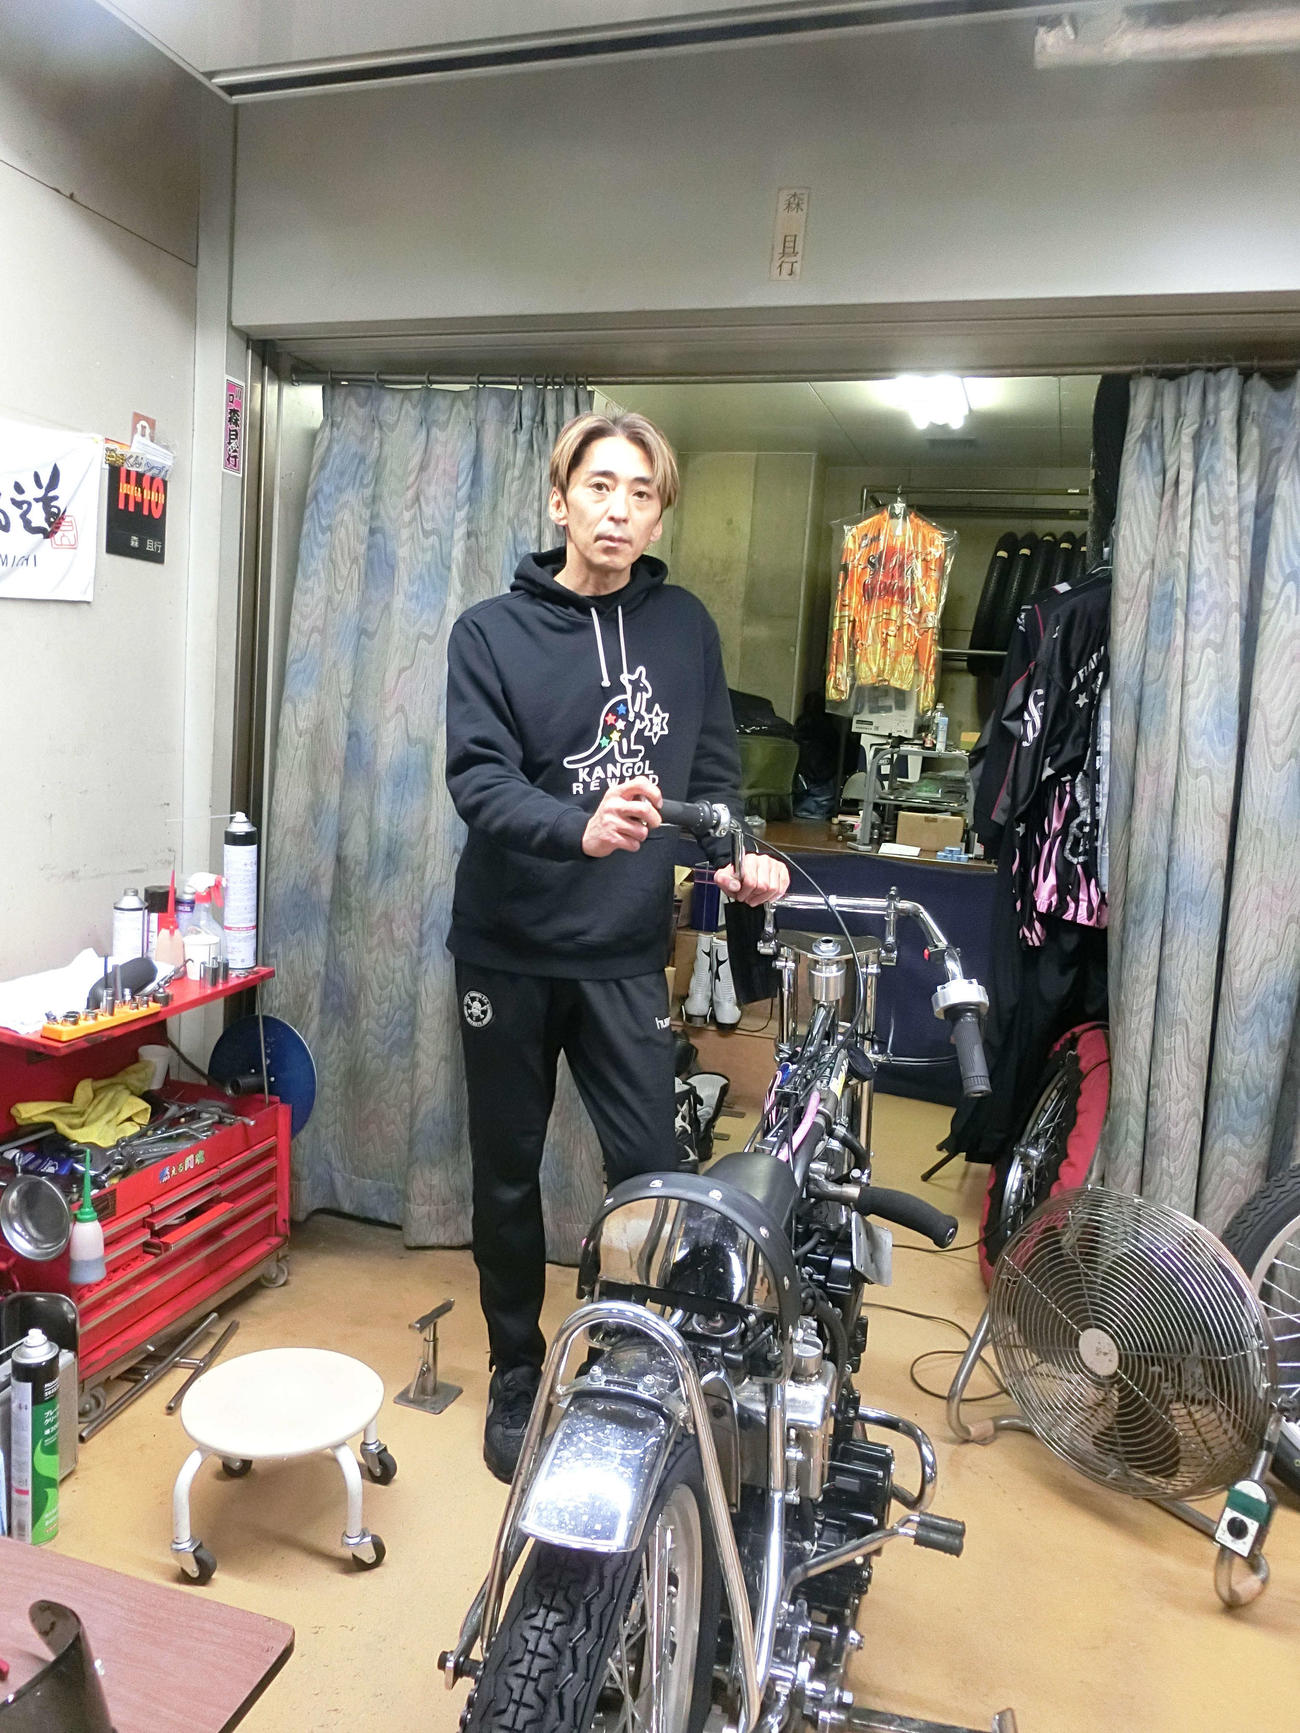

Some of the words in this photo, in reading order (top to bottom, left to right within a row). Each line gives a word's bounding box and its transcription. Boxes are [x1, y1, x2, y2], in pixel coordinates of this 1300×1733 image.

[783, 191, 805, 214] 森
[118, 467, 164, 519] H-10
[578, 760, 654, 782] KANGOL
[572, 775, 659, 795] REWD
